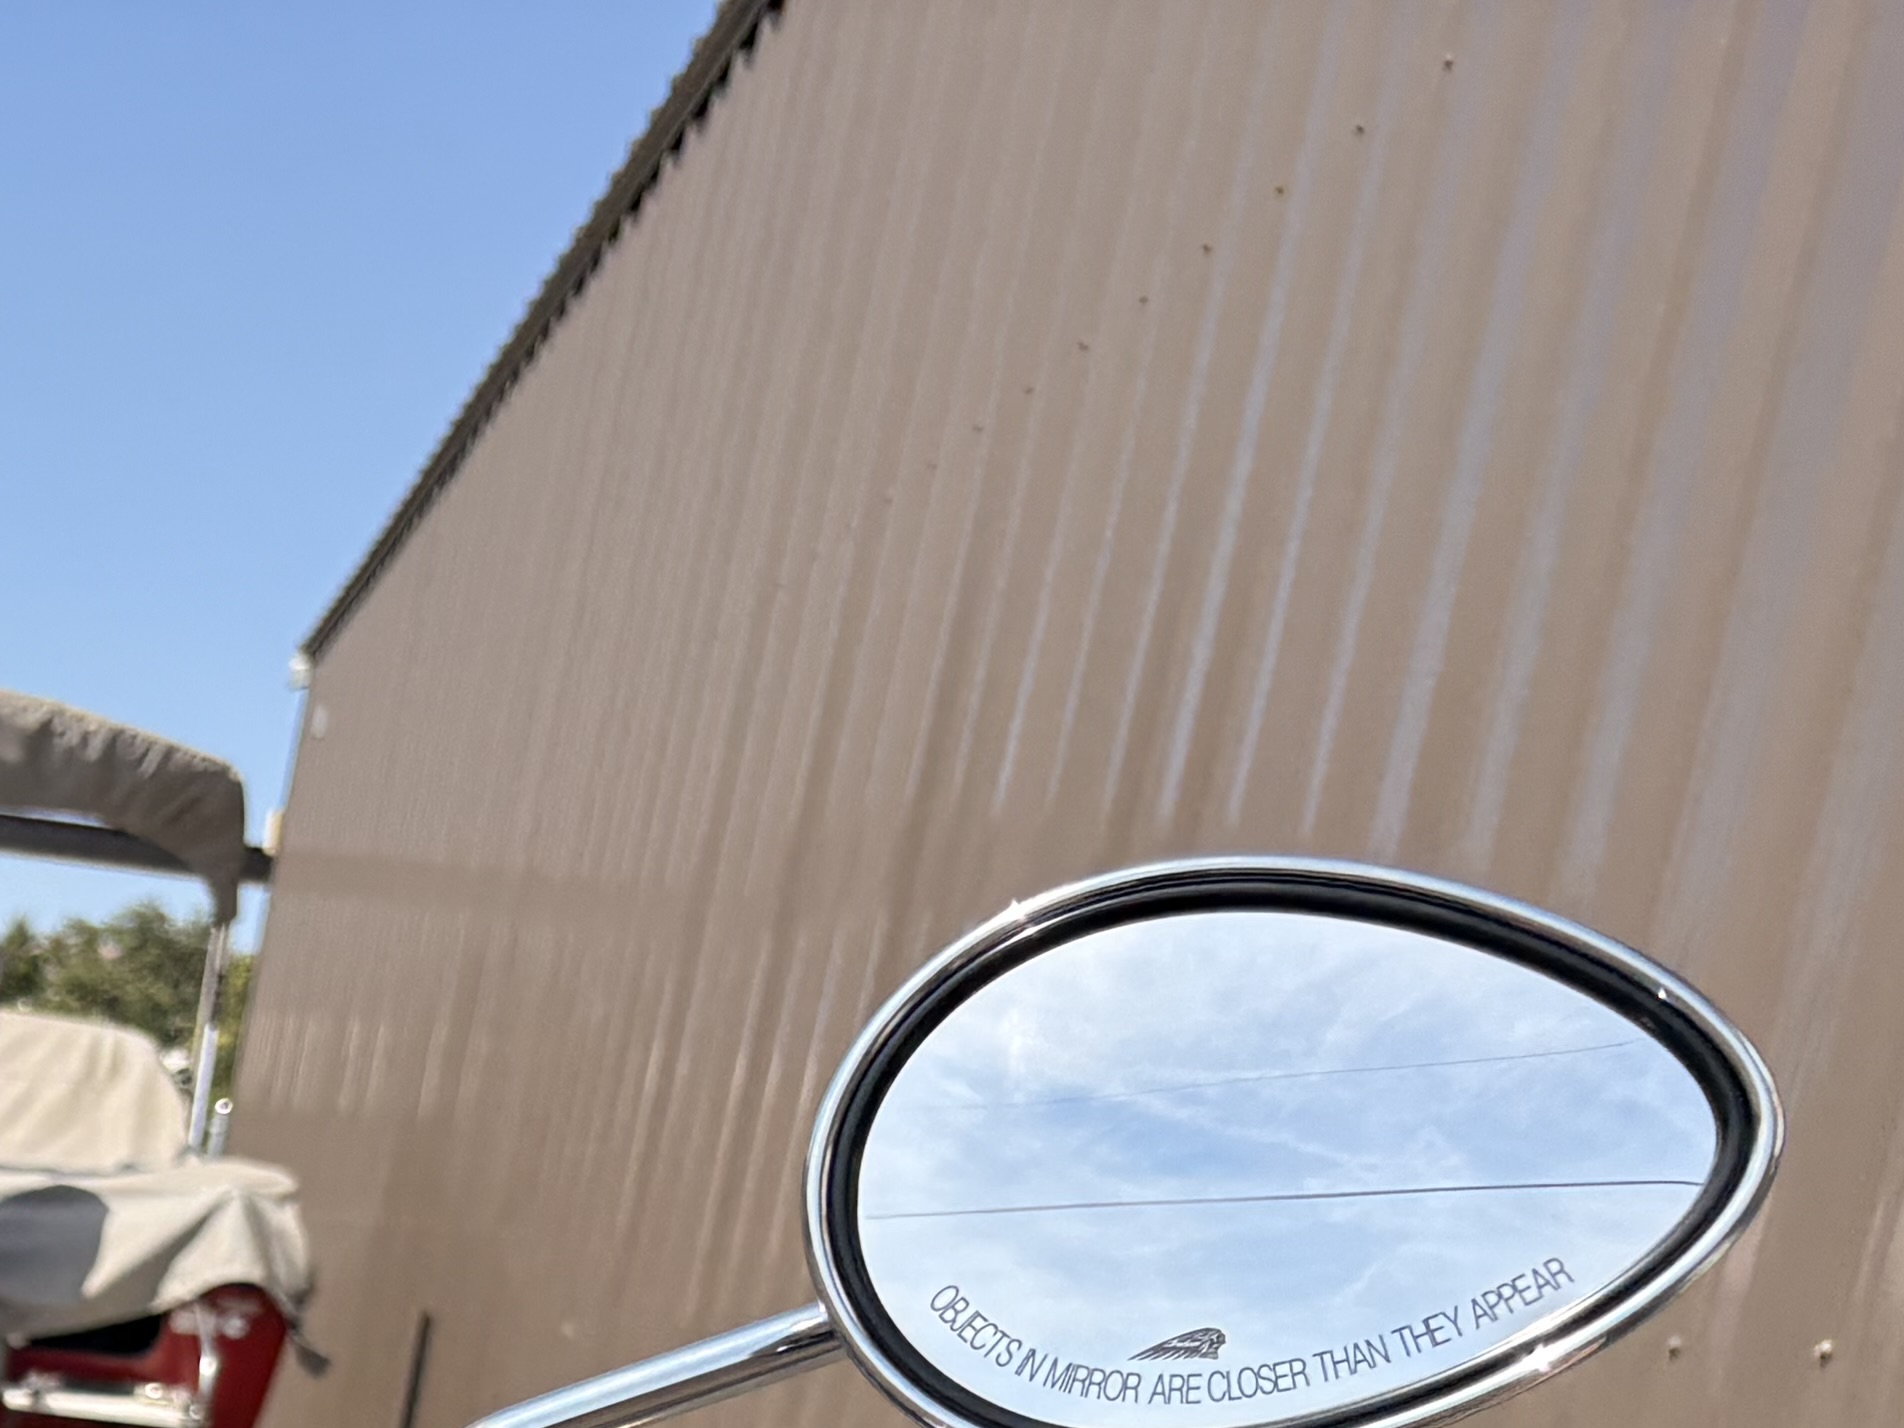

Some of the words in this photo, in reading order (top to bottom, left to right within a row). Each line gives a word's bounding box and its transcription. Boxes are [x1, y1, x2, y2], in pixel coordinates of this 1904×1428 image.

[929, 1284, 1020, 1368] OBJECTS
[1017, 1347, 1044, 1384] IN
[1042, 1357, 1140, 1404] MIRROR
[1147, 1371, 1203, 1405] ARE
[1206, 1361, 1311, 1402] CLOSER
[1313, 1336, 1392, 1386] THAN
[1390, 1306, 1464, 1358] THEY
[1471, 1257, 1575, 1331] APPEAR
